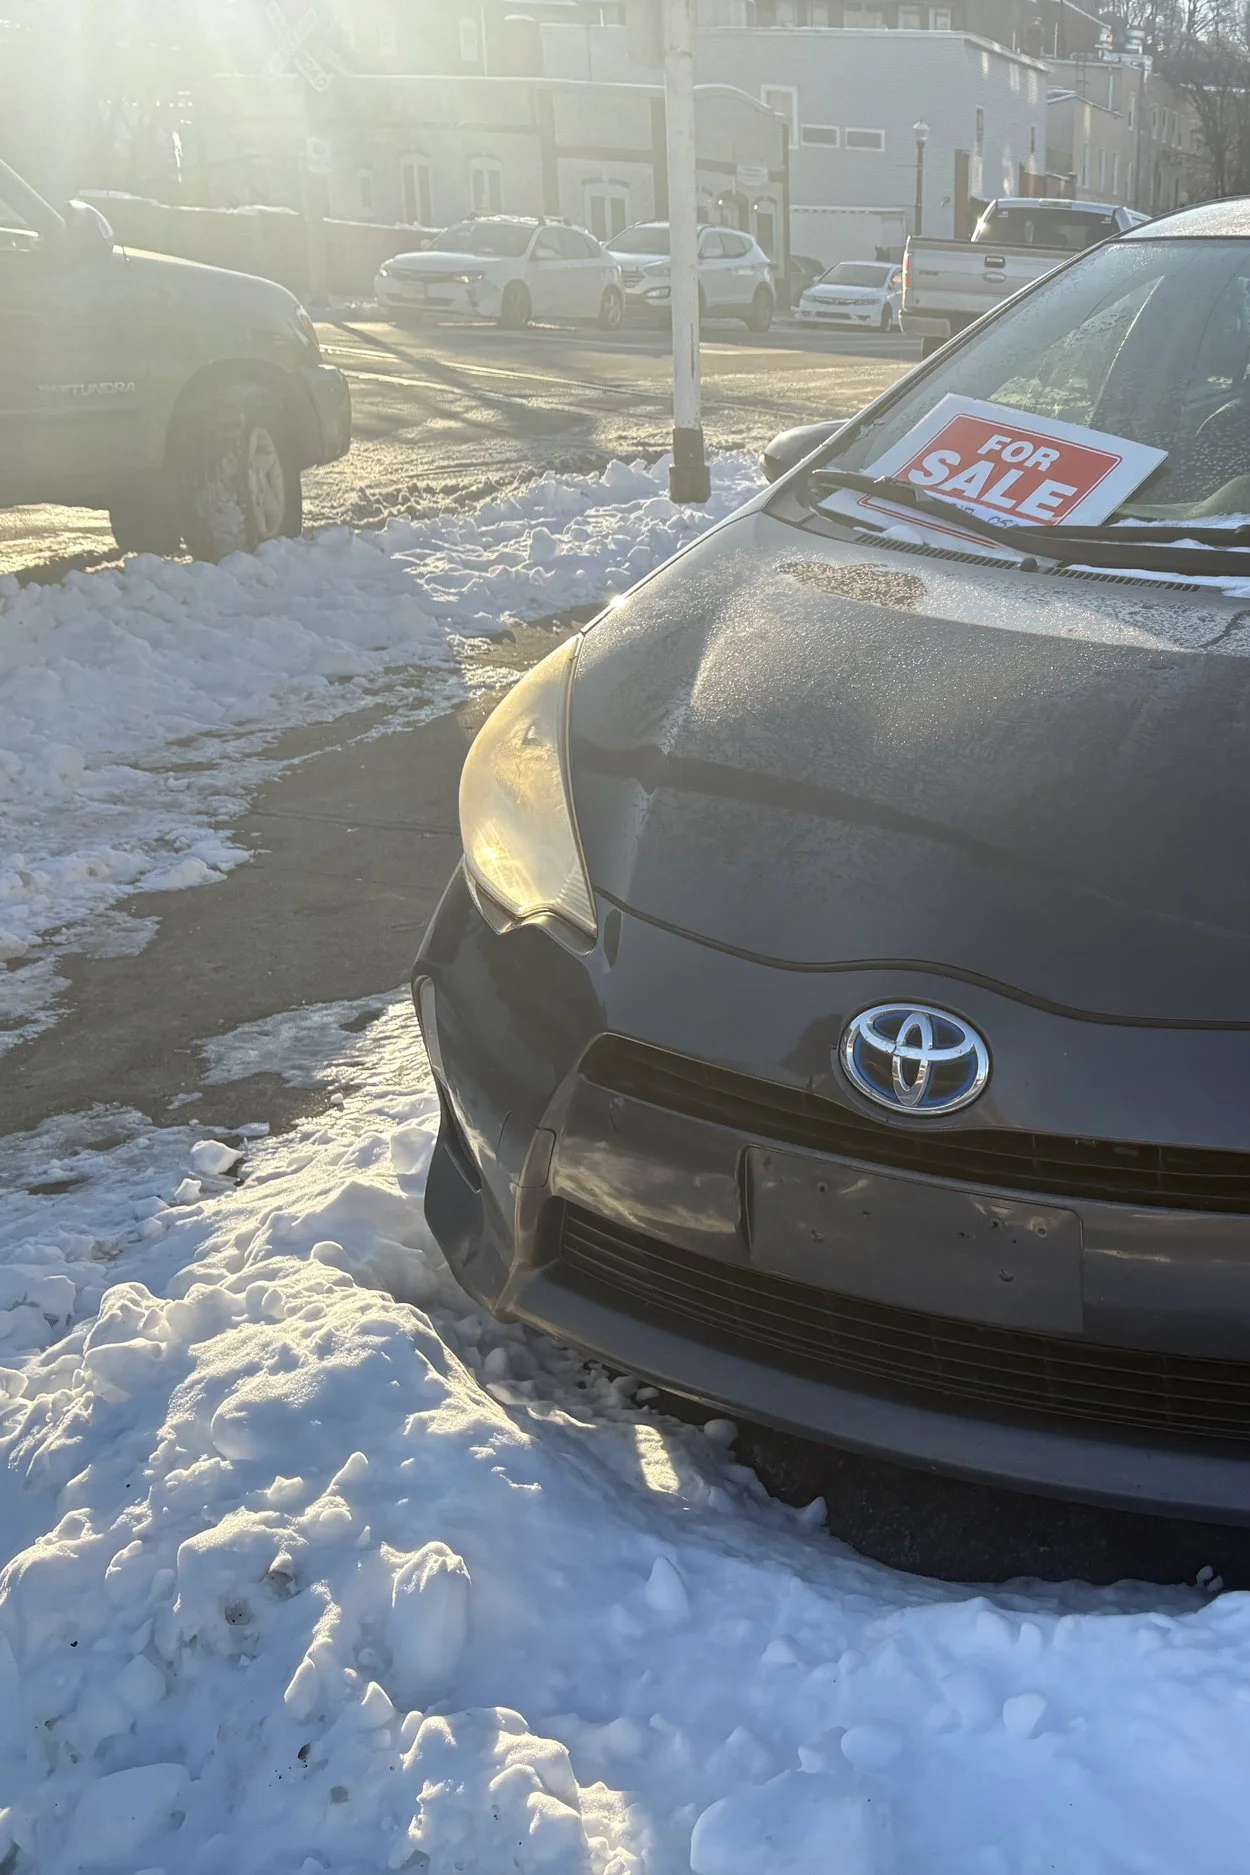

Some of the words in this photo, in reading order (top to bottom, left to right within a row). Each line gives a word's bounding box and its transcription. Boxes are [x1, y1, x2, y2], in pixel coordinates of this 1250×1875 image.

[69, 381, 136, 396] TUNDRA
[977, 434, 1060, 472] FOR
[908, 449, 1078, 521] SALE
